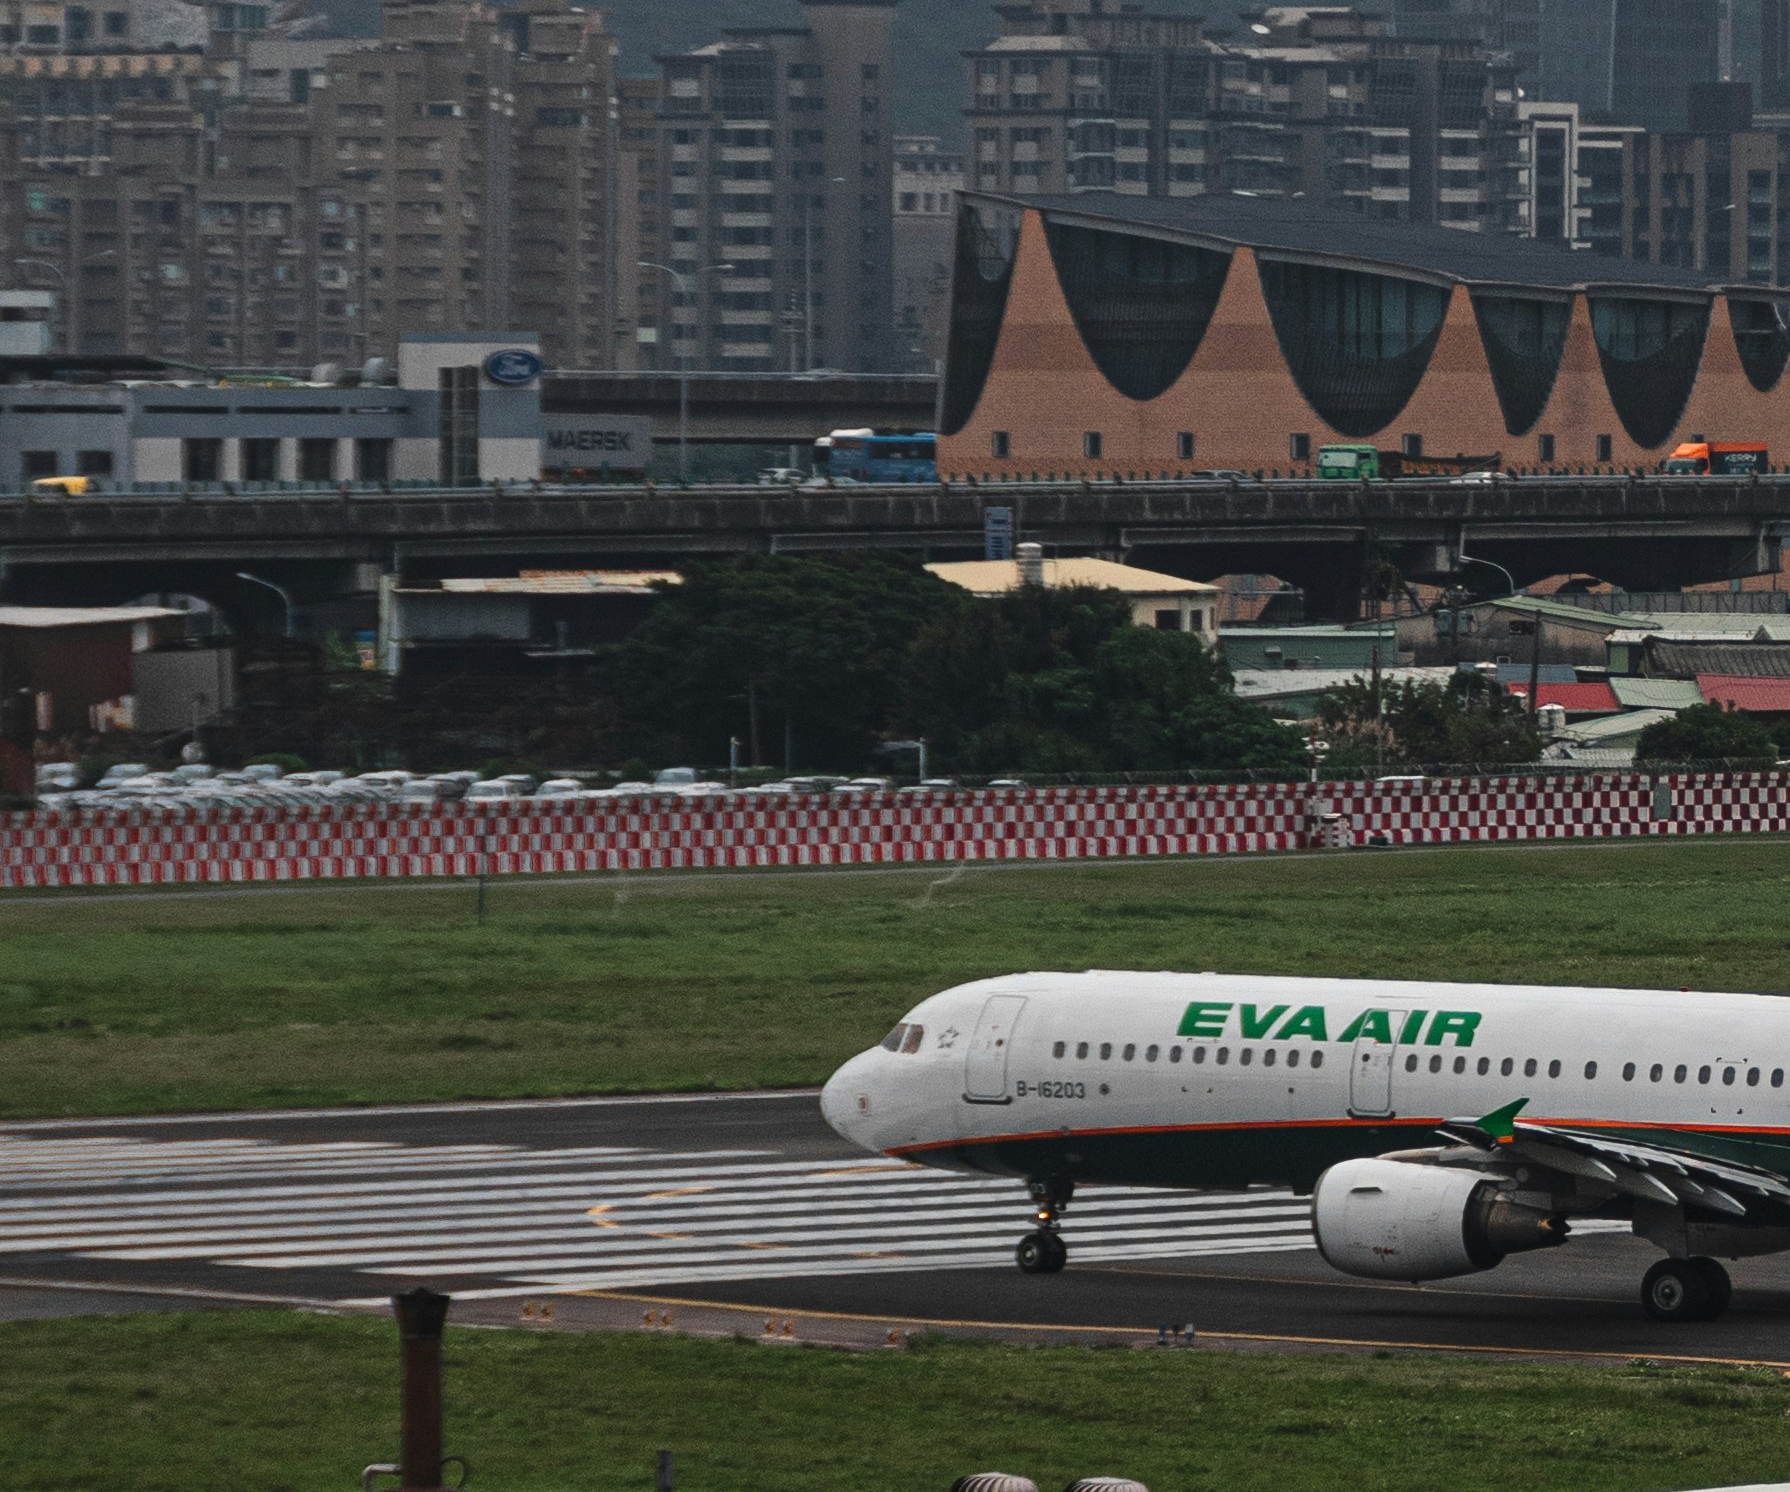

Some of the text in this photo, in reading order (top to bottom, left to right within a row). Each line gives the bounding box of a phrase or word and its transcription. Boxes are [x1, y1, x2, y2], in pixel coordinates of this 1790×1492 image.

[548, 430, 631, 451] MAERSK
[1176, 1002, 1482, 1047] EVA AIR
[1016, 1080, 1086, 1099] B-16203
